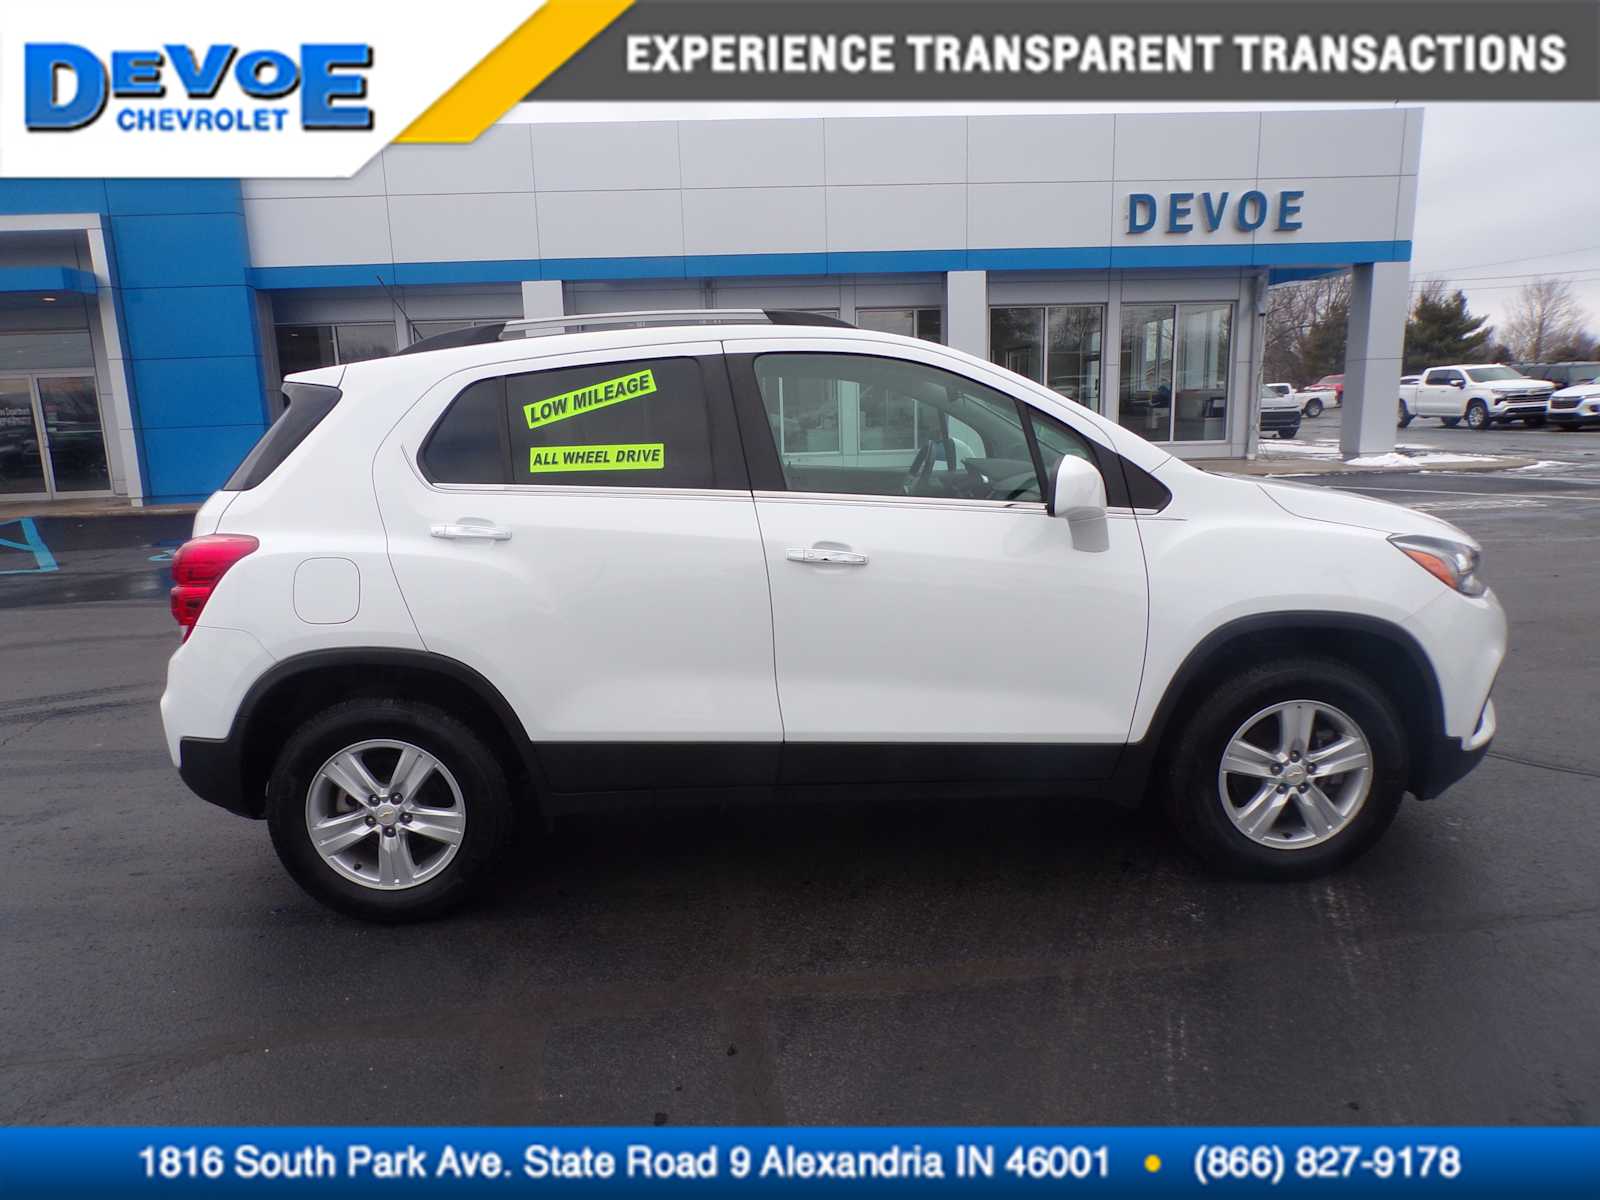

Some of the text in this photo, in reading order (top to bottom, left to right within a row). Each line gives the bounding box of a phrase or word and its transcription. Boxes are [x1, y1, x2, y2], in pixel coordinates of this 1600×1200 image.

[1127, 190, 1304, 234] DEVOE
[530, 374, 650, 423] LOW MILEAGE
[533, 449, 661, 466] ALL WHEEL DRIVE
